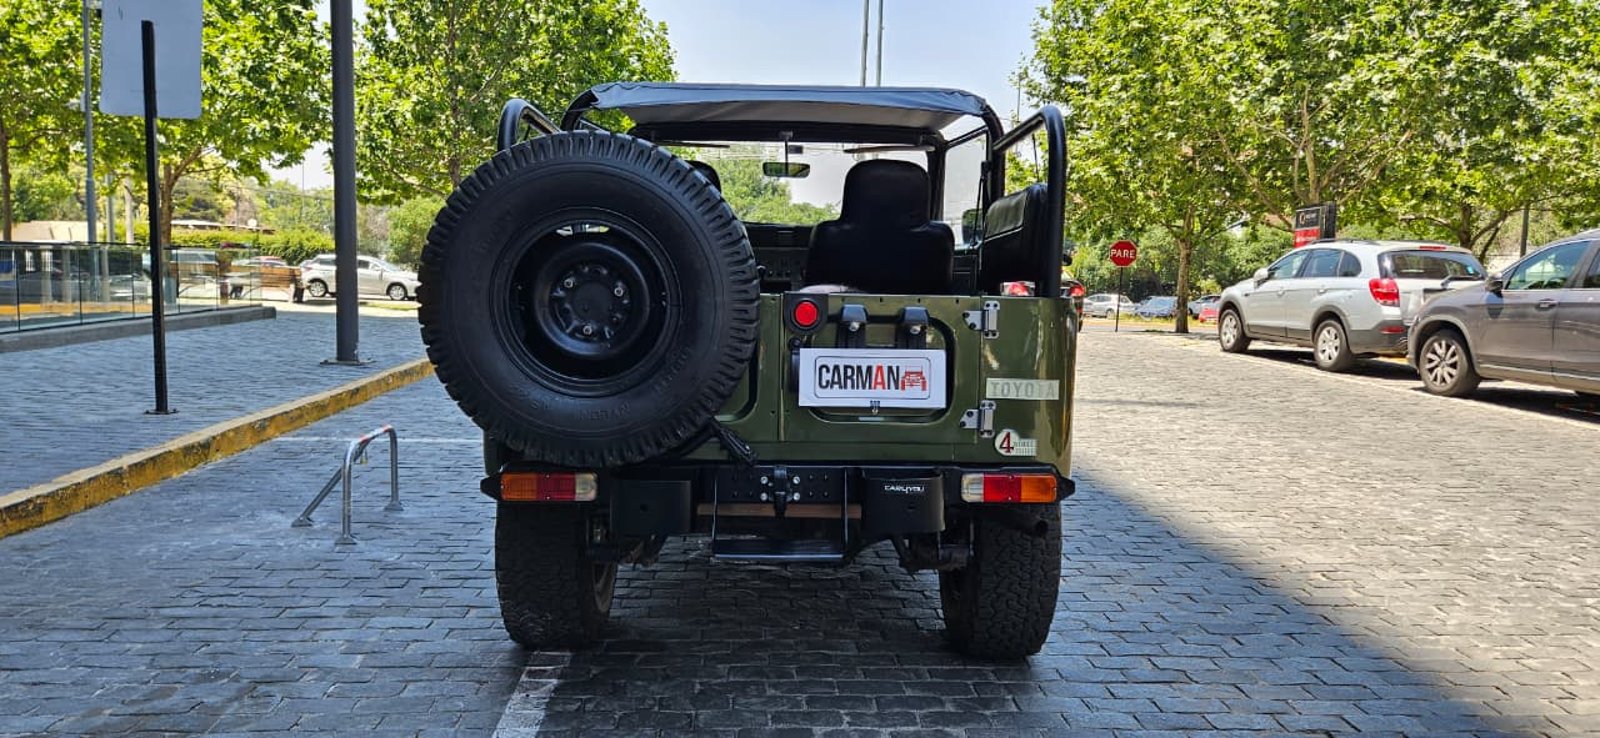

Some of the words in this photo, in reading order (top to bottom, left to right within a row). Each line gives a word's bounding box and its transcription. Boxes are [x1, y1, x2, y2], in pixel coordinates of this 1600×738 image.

[1110, 249, 1136, 259] PARE
[818, 364, 900, 391] CARMAN
[990, 381, 1056, 398] TOYOTA
[999, 431, 1015, 453] 4
